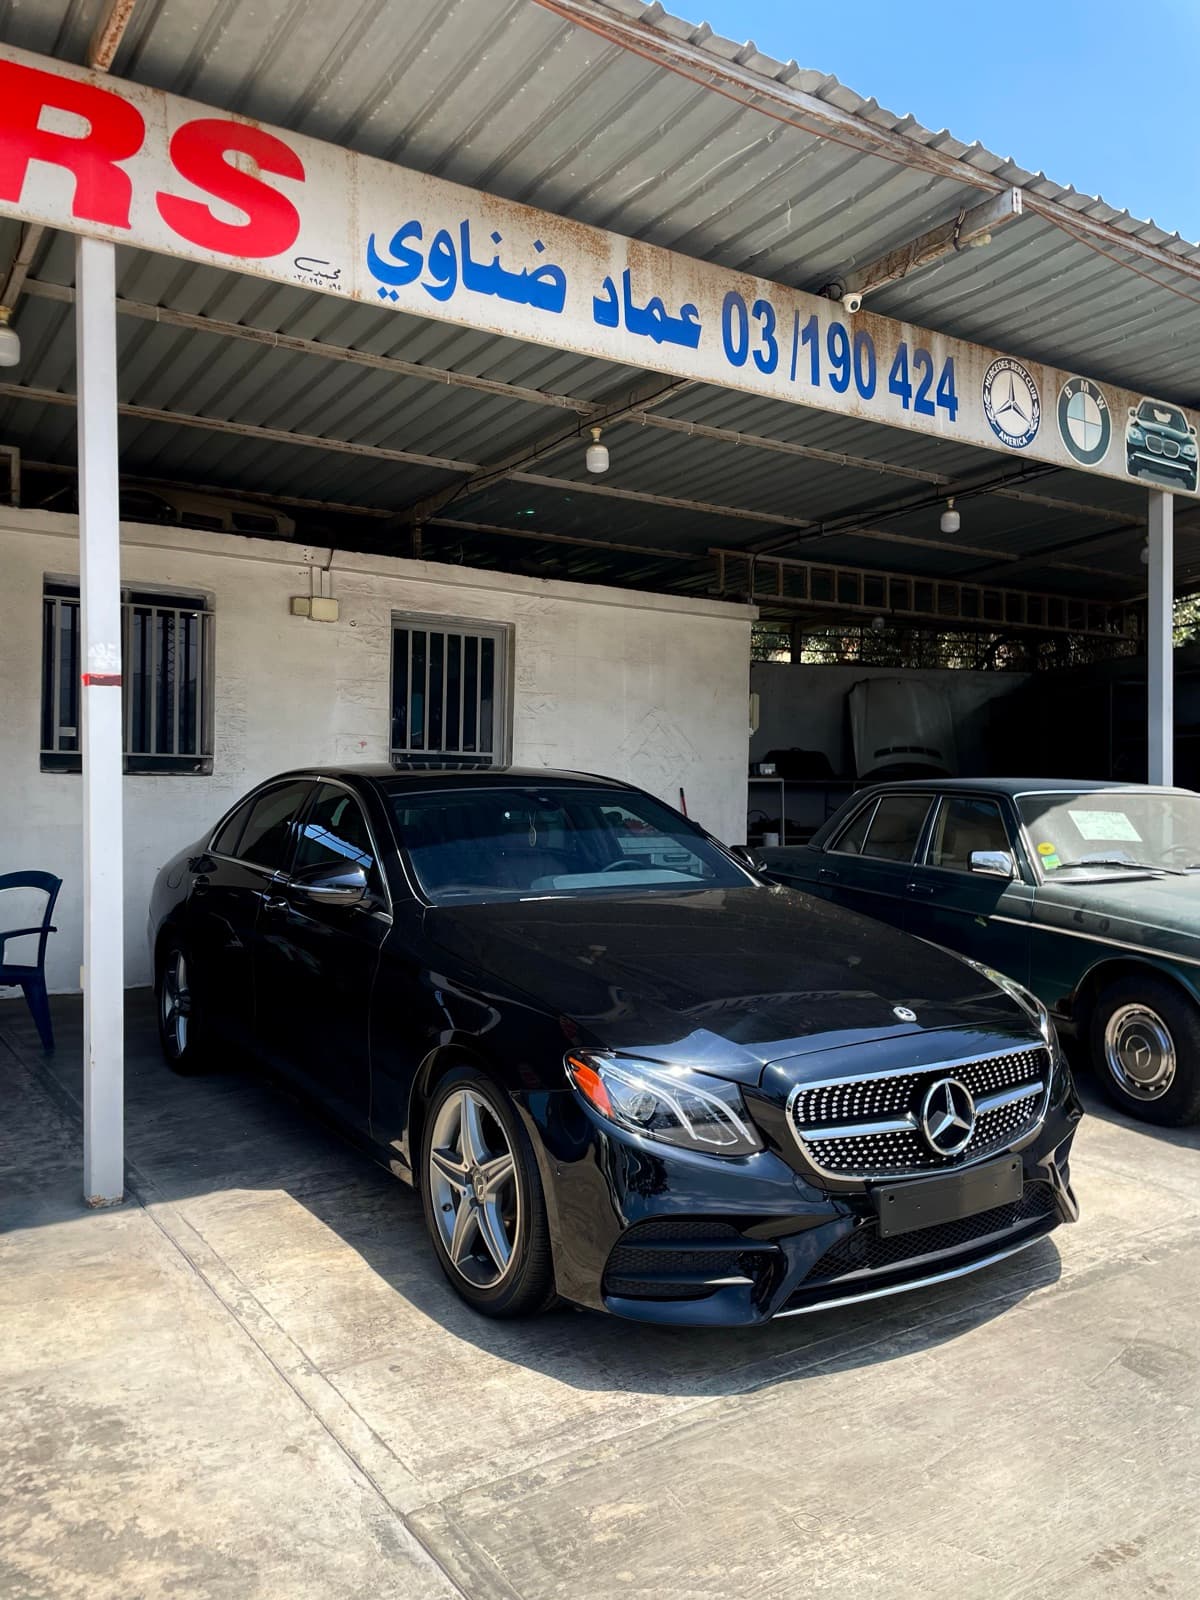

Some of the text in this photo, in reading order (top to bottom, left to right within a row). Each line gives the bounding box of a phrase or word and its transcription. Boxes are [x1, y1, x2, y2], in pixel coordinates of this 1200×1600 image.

[366, 219, 702, 349] عماد ضناوي
[888, 342, 959, 423] 424
[1025, 378, 1037, 399] CLUB
[999, 431, 1028, 446] AMERICA
